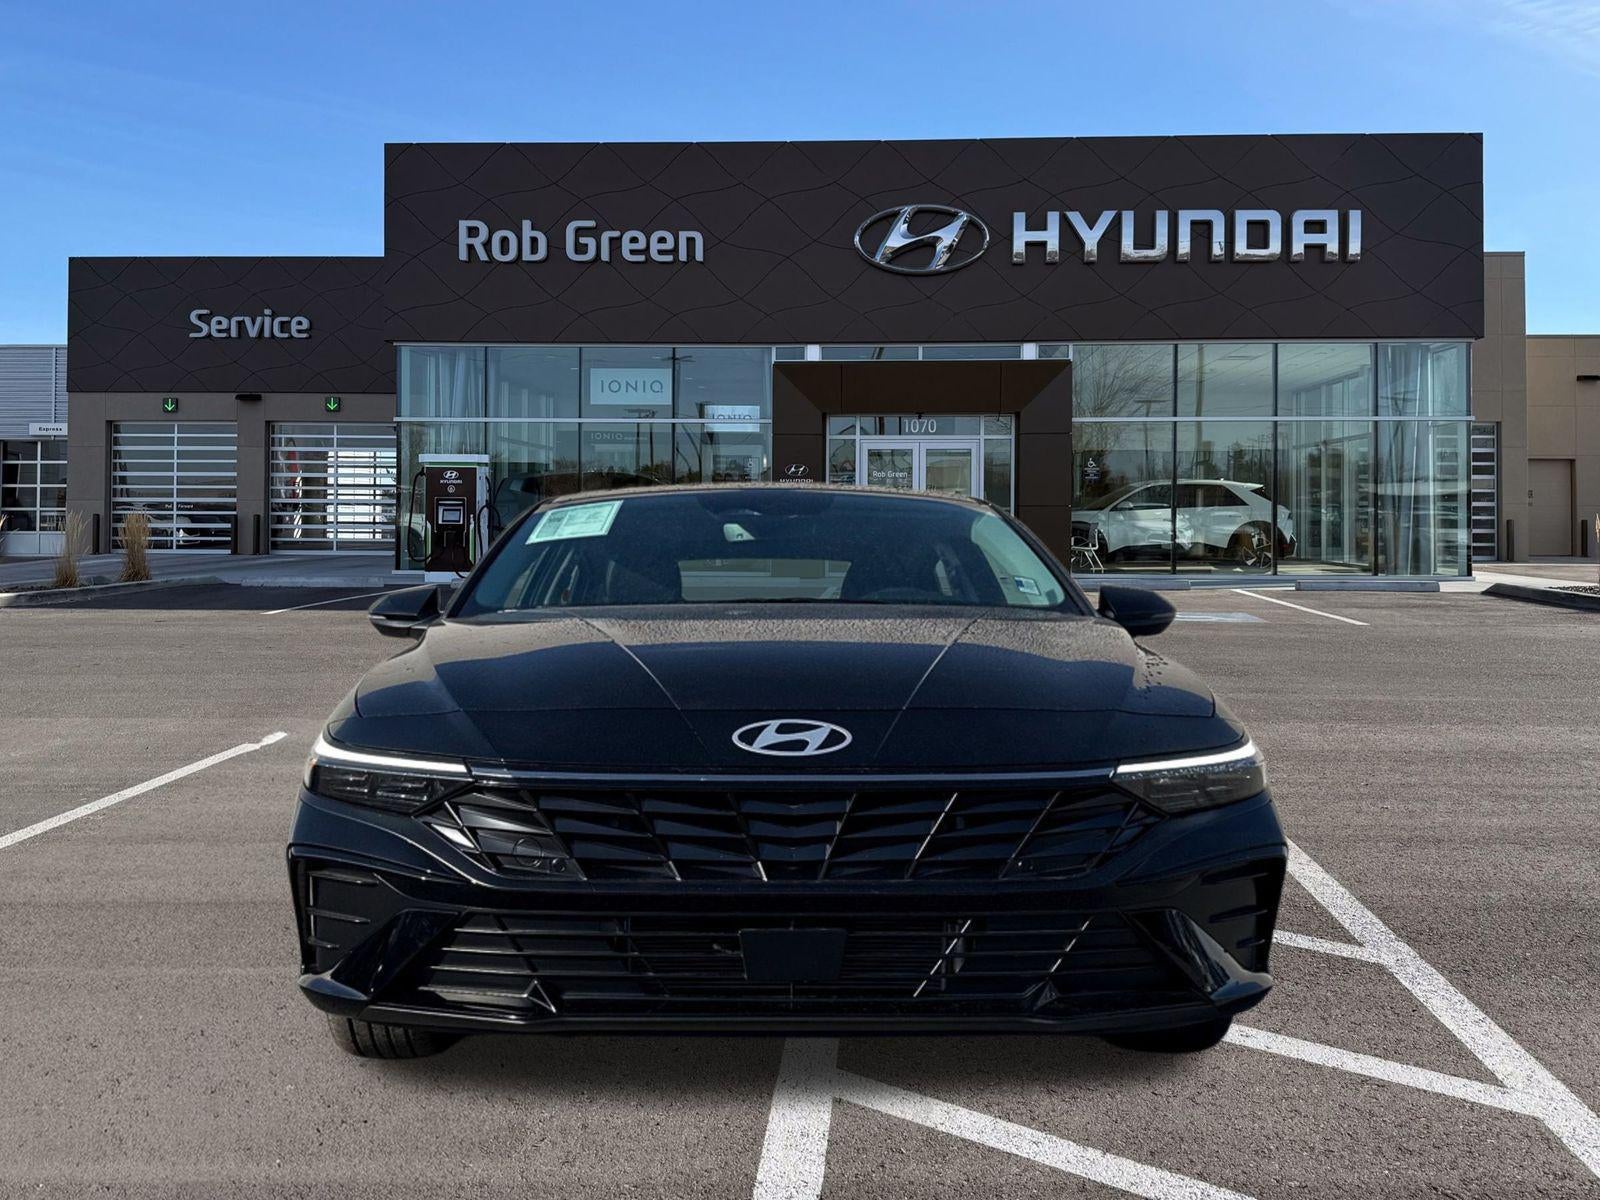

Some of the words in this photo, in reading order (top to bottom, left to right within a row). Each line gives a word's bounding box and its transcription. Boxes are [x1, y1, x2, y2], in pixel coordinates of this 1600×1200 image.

[458, 219, 548, 262] Rob
[565, 219, 704, 262] Green
[1011, 209, 1362, 264] HYUNDAI
[189, 308, 311, 338] Service
[600, 379, 664, 394] IONIQ
[903, 418, 937, 433] 1070
[591, 432, 624, 440] IONIQ
[872, 470, 886, 478] Rob
[887, 470, 908, 478] Green
